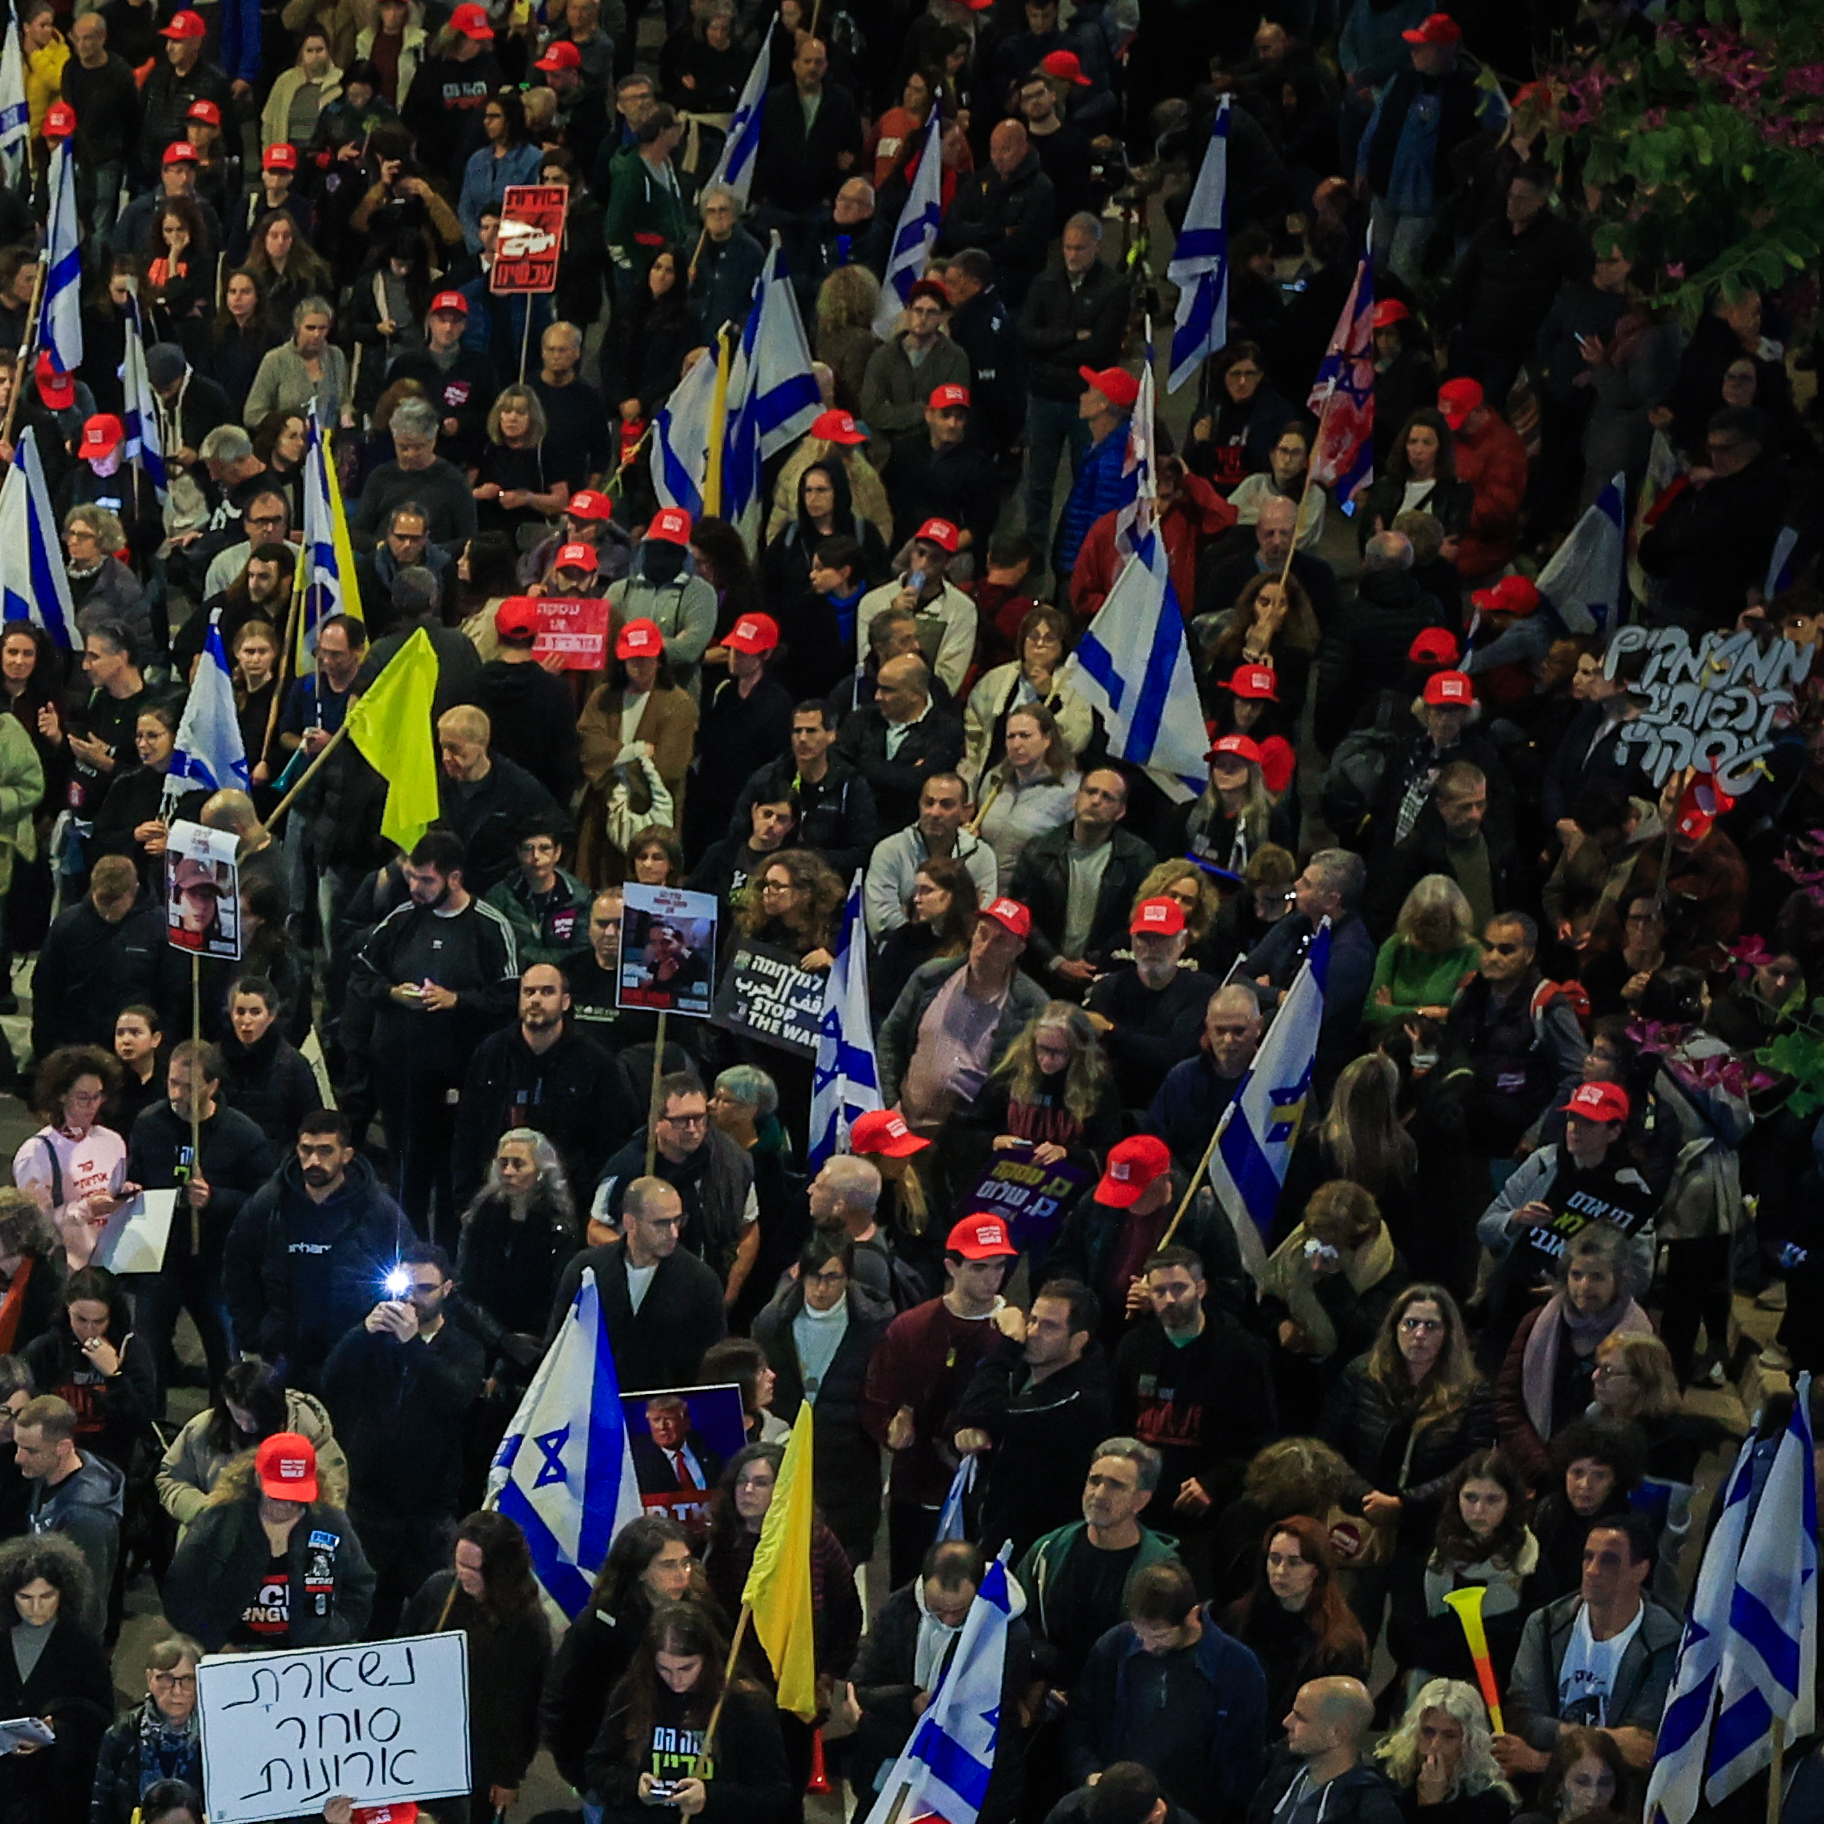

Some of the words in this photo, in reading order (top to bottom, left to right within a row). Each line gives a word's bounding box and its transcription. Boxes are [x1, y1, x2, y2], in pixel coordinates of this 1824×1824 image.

[748, 1012, 779, 1035] THE
[782, 1023, 821, 1048] WAR
[752, 998, 797, 1021] STOP
[220, 1646, 418, 1710] נשארת
[274, 1705, 403, 1750] סוחר
[239, 1748, 419, 1804] ארונות
